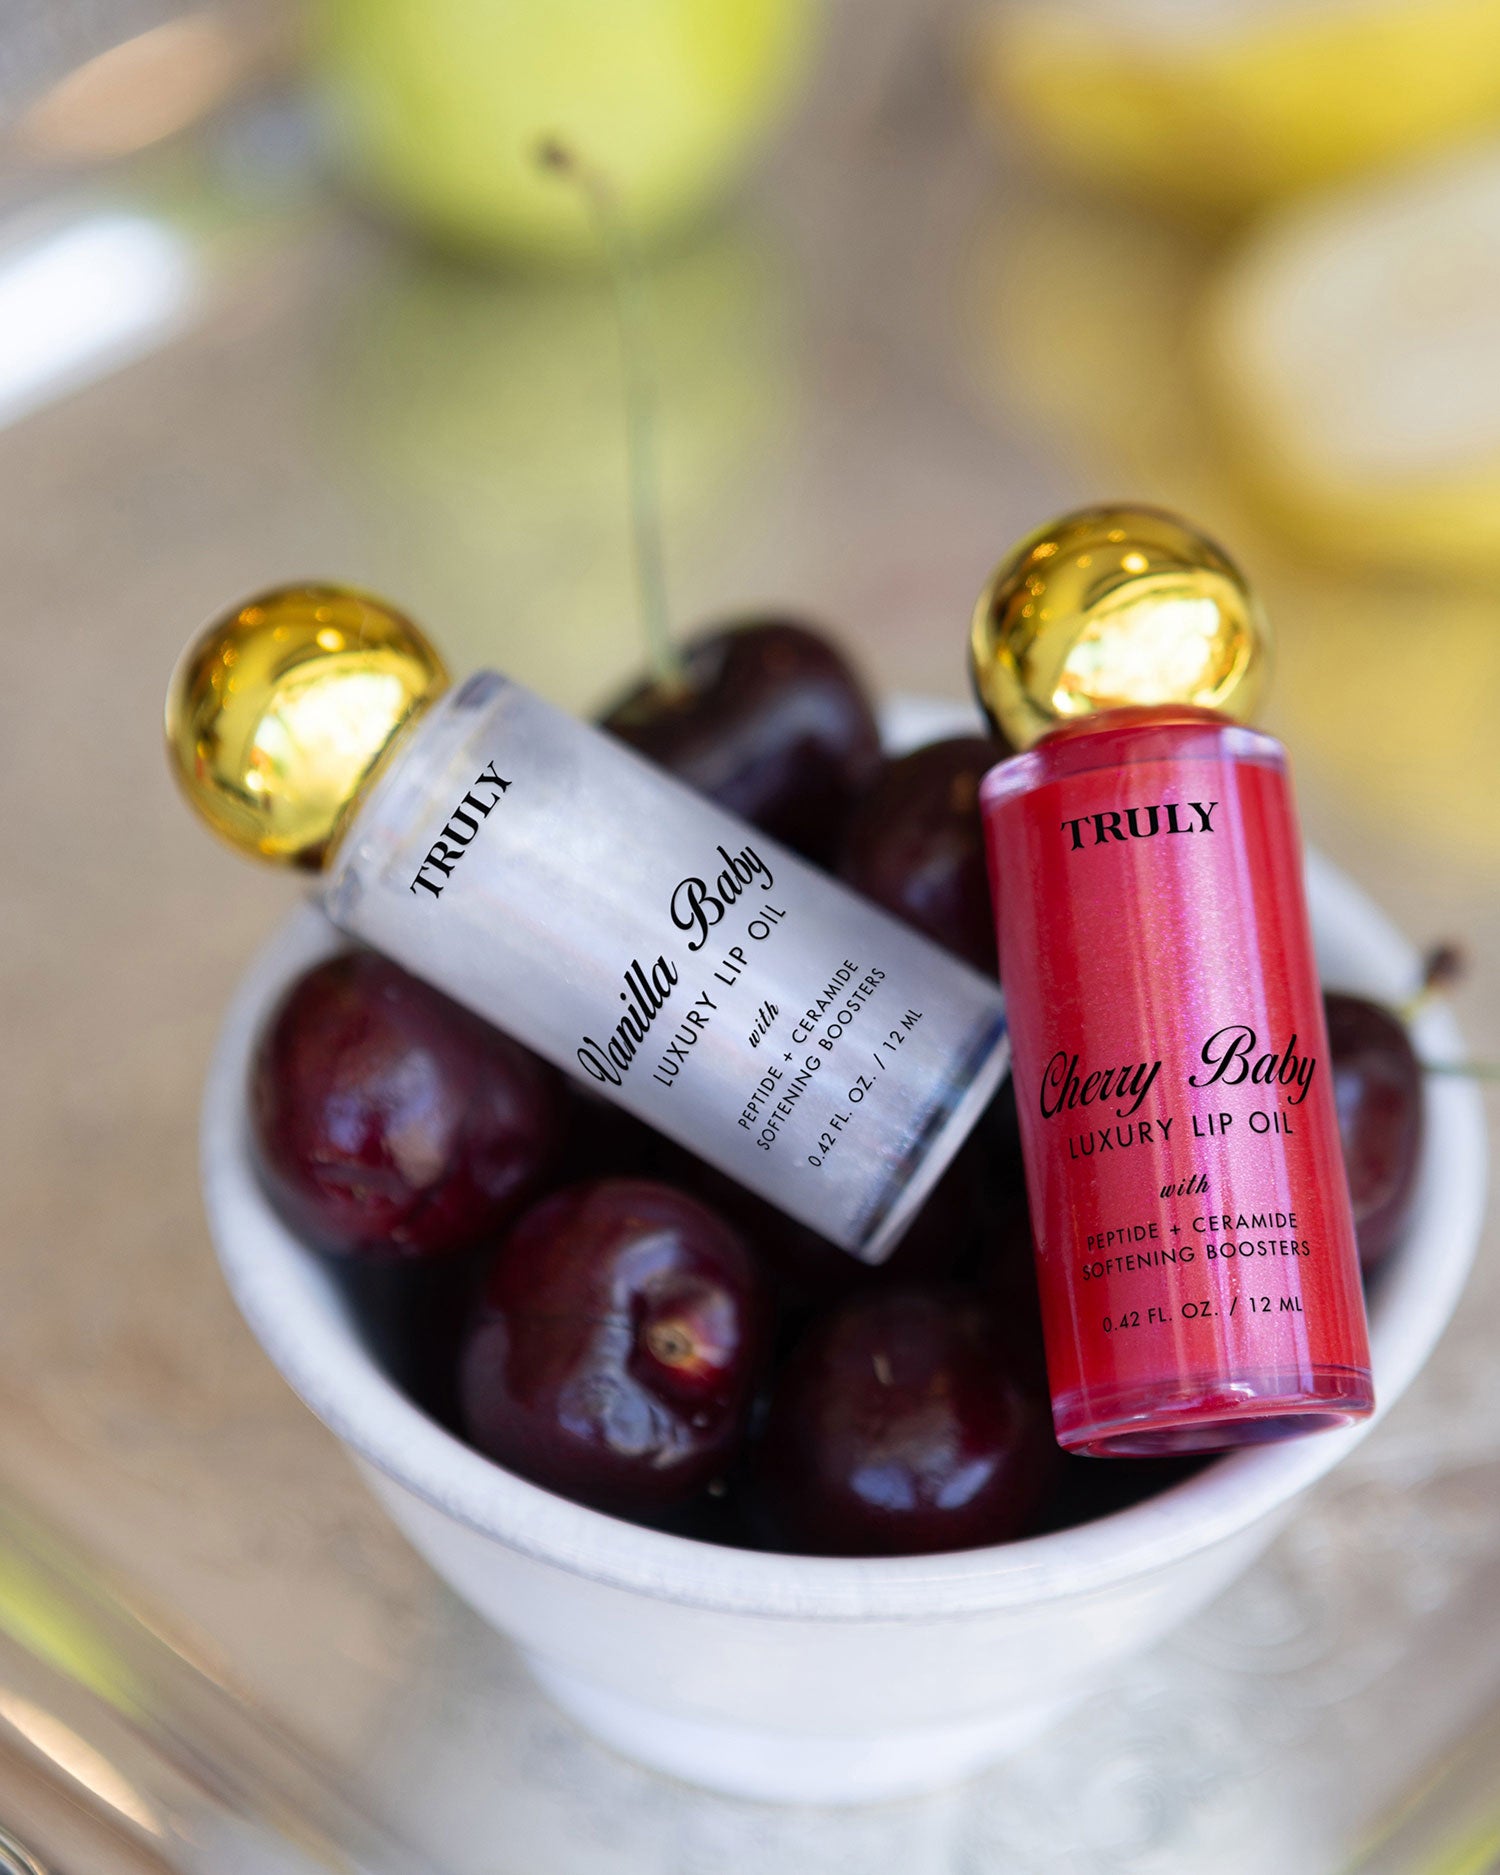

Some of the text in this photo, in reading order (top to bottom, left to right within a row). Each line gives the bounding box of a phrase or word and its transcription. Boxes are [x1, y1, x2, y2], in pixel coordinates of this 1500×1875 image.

[410, 760, 512, 898] TRULY
[1061, 801, 1218, 851] TRULY
[577, 846, 773, 1086] Vanilla Baby
[653, 904, 786, 1087] LUXURY LIP OIL
[738, 959, 859, 1130] PEPTIDE + CERAMIDE
[748, 1000, 779, 1048] with
[757, 967, 886, 1150] SOFTENING BOOSTERS
[808, 1009, 923, 1167] 0.42 FL. OZ. / 12 ML
[1040, 1025, 1316, 1118] Cherry Baby
[1069, 1111, 1293, 1159] LUXURY LIP OIL
[1159, 1173, 1209, 1198] with
[1082, 1240, 1311, 1281] SOFTENING BOOSTERS
[1087, 1213, 1298, 1251] PEPTIDE + CERAMIDE
[1103, 1296, 1302, 1333] 0.42 FL. OZ. / 12 ML
